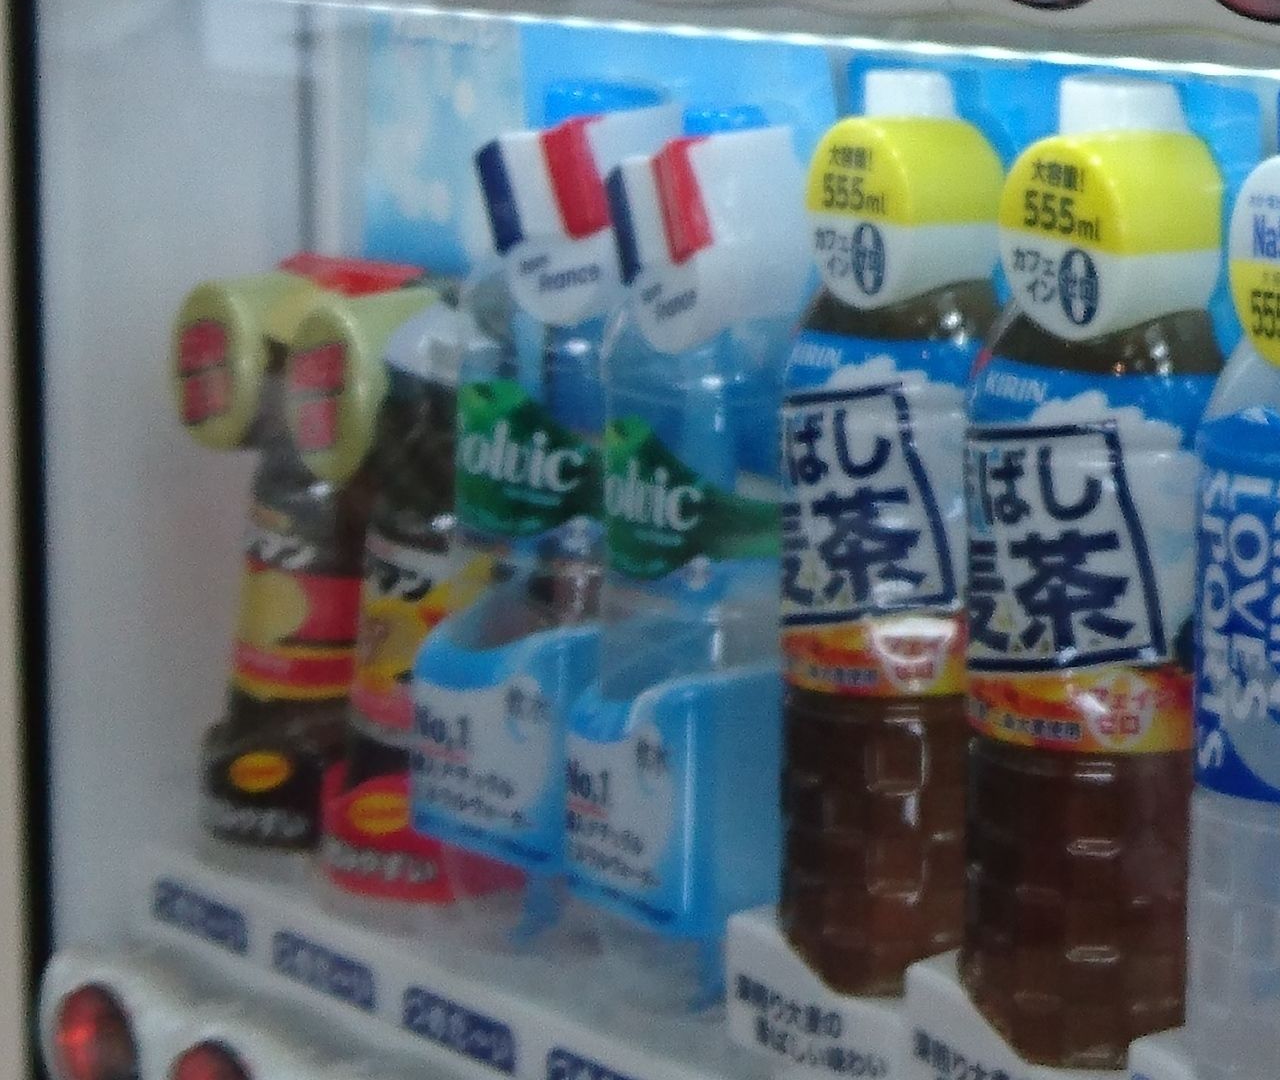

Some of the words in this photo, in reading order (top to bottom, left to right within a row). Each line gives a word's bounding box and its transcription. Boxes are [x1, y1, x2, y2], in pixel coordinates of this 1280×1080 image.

[822, 172, 886, 215] 555ml
[1024, 189, 1100, 241] 555ml
[1225, 474, 1274, 722] LOVES
